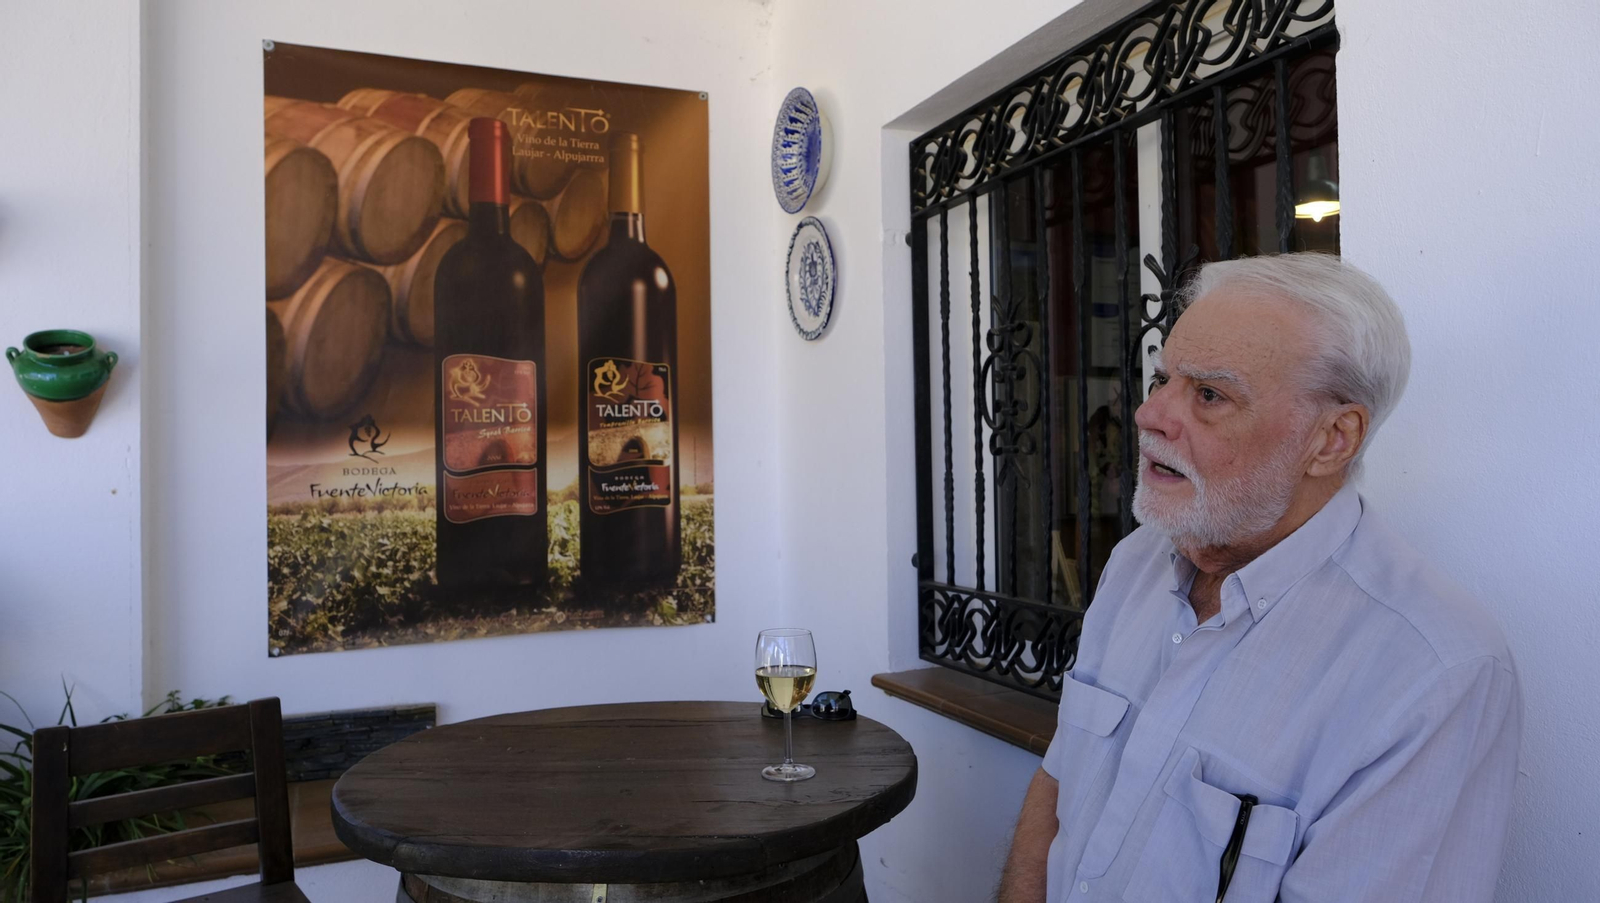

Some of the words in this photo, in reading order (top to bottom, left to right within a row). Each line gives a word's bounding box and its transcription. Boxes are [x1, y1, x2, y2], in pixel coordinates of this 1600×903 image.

[507, 107, 609, 134] TALENTO
[517, 133, 542, 145] Vino
[543, 136, 557, 146] de
[559, 137, 568, 147] la
[569, 138, 600, 150] Tierra
[512, 145, 545, 159] Laujar
[451, 403, 532, 423] TALENTO
[596, 400, 663, 417] TALENTO
[342, 467, 397, 476] BODEGA
[310, 477, 428, 499] FuenteVictoria
